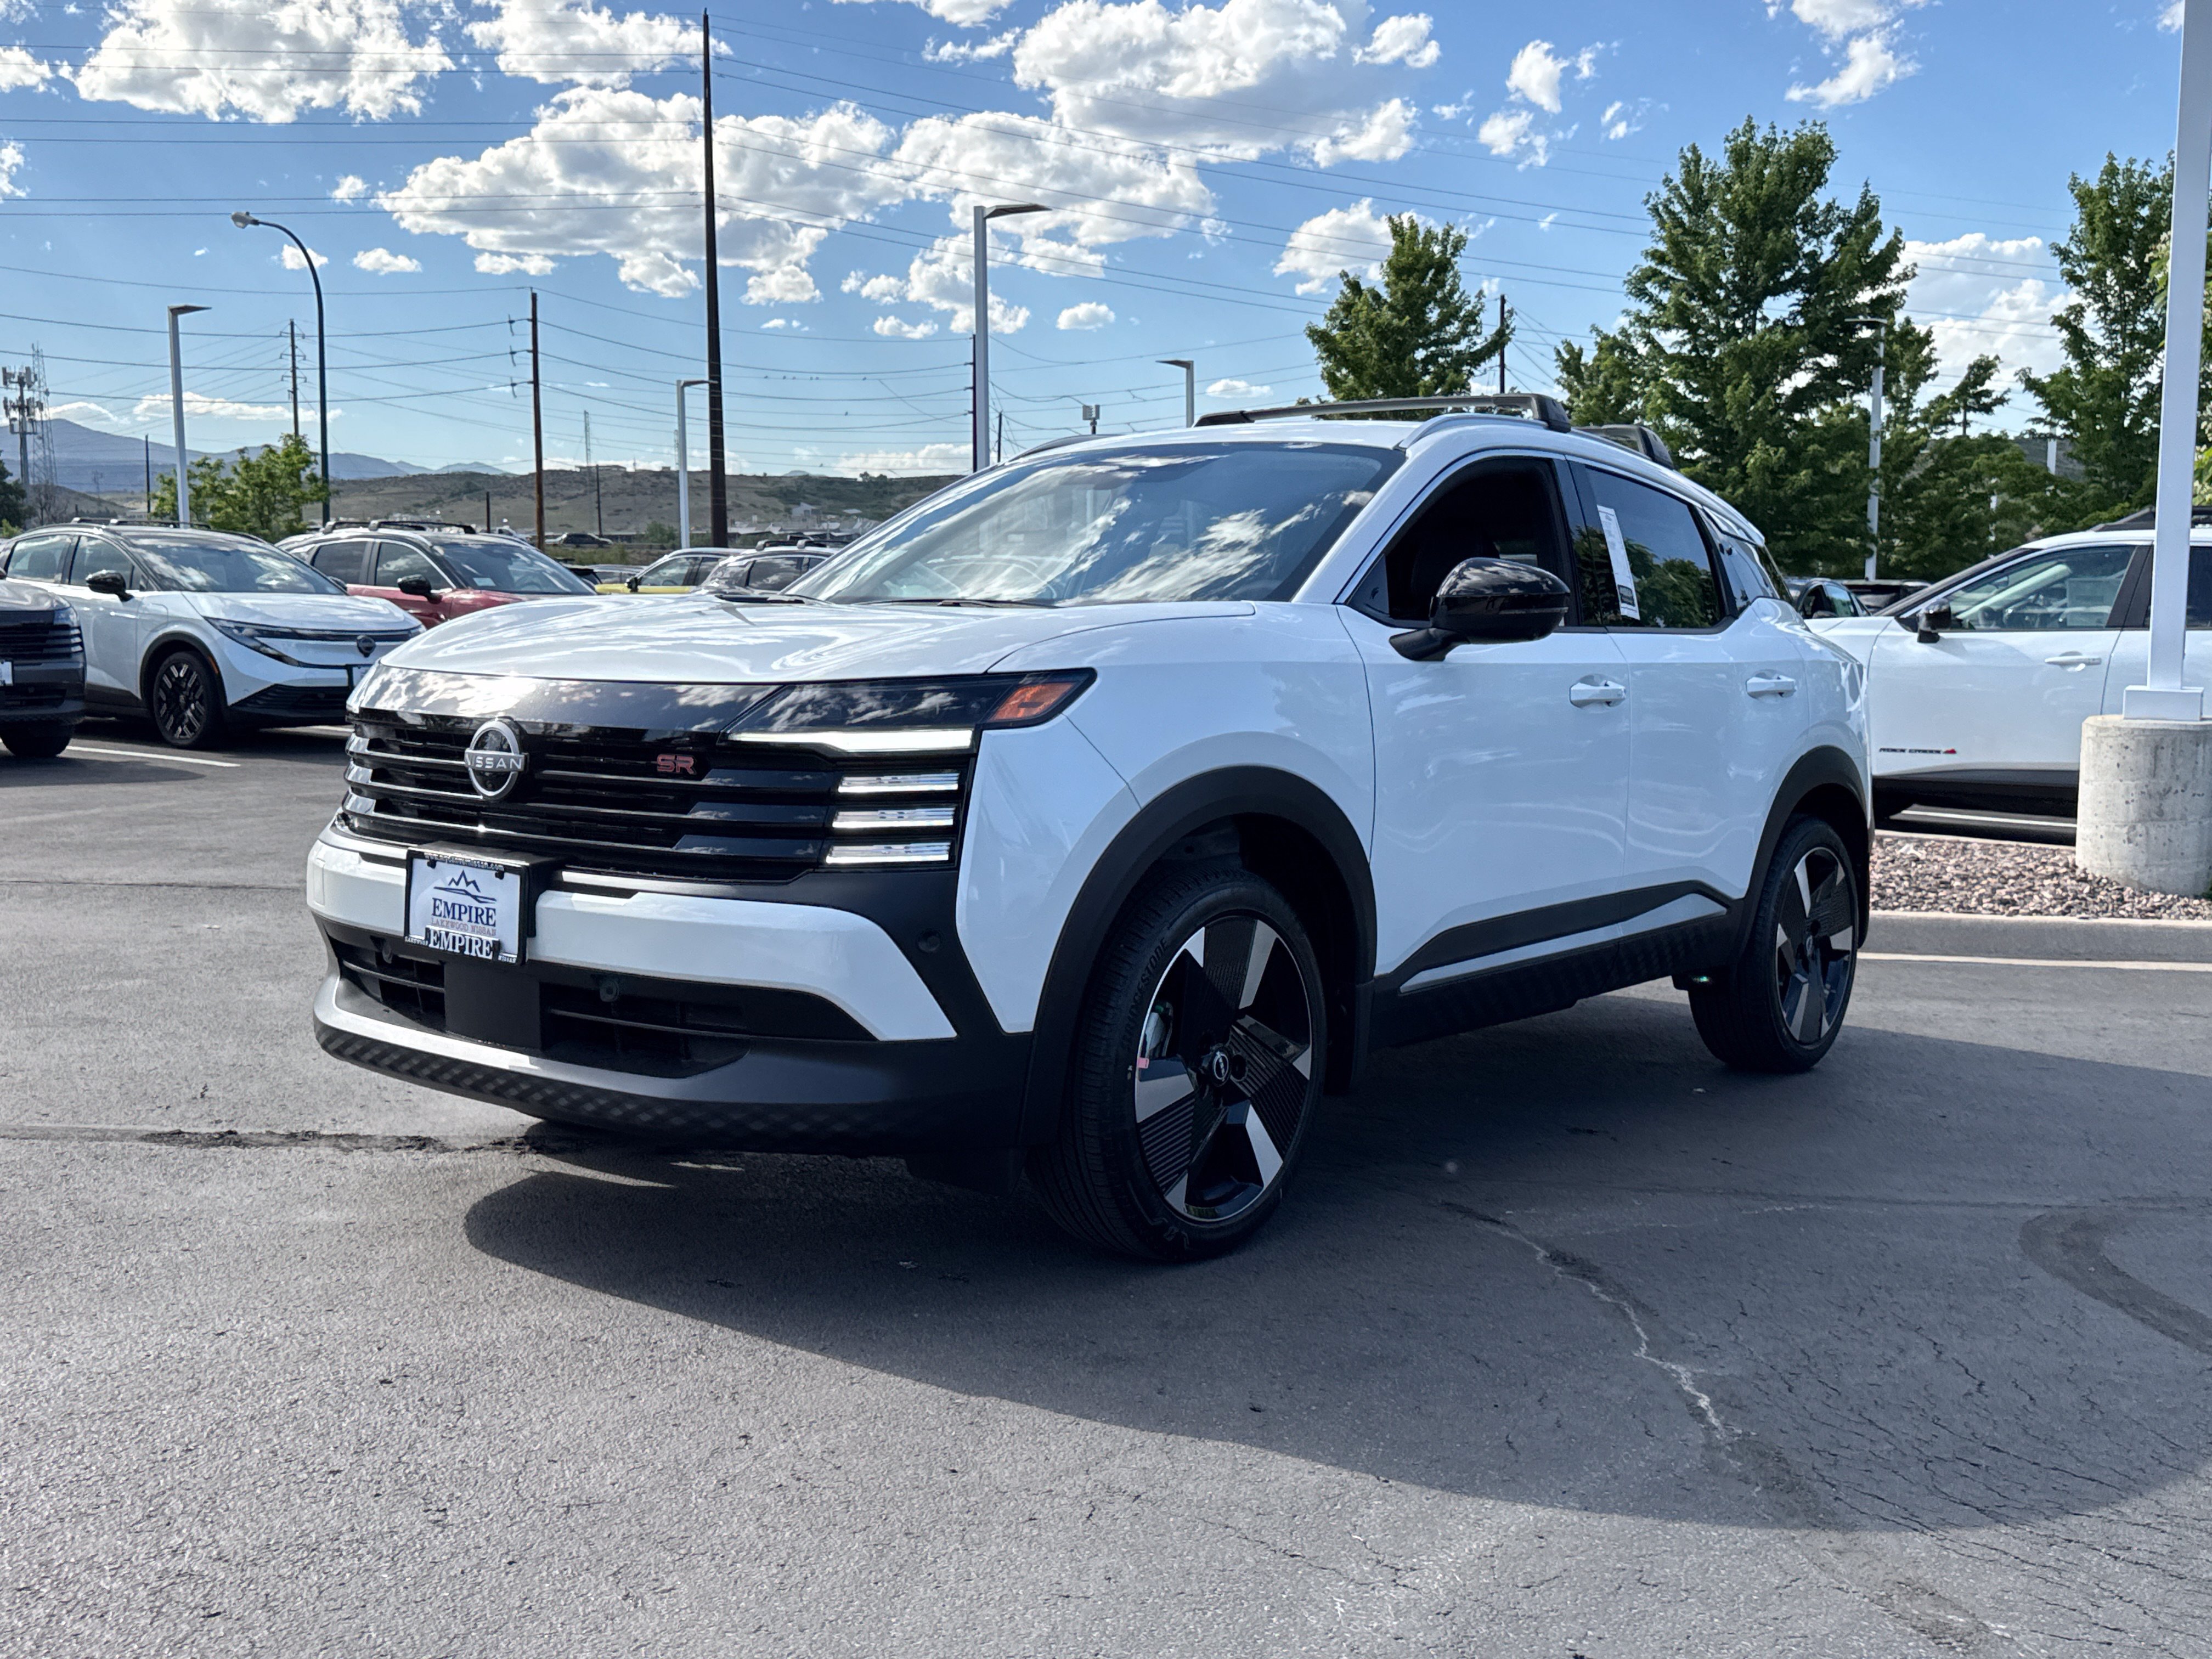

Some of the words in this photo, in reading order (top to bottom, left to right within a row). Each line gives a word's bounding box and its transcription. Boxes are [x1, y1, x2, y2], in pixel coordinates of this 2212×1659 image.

[657, 754, 697, 775] SR
[432, 897, 496, 927] EMPIRE
[431, 917, 469, 933] LAKEWOOD
[471, 924, 496, 936] NISSAN
[428, 928, 493, 960] EMPIRE
